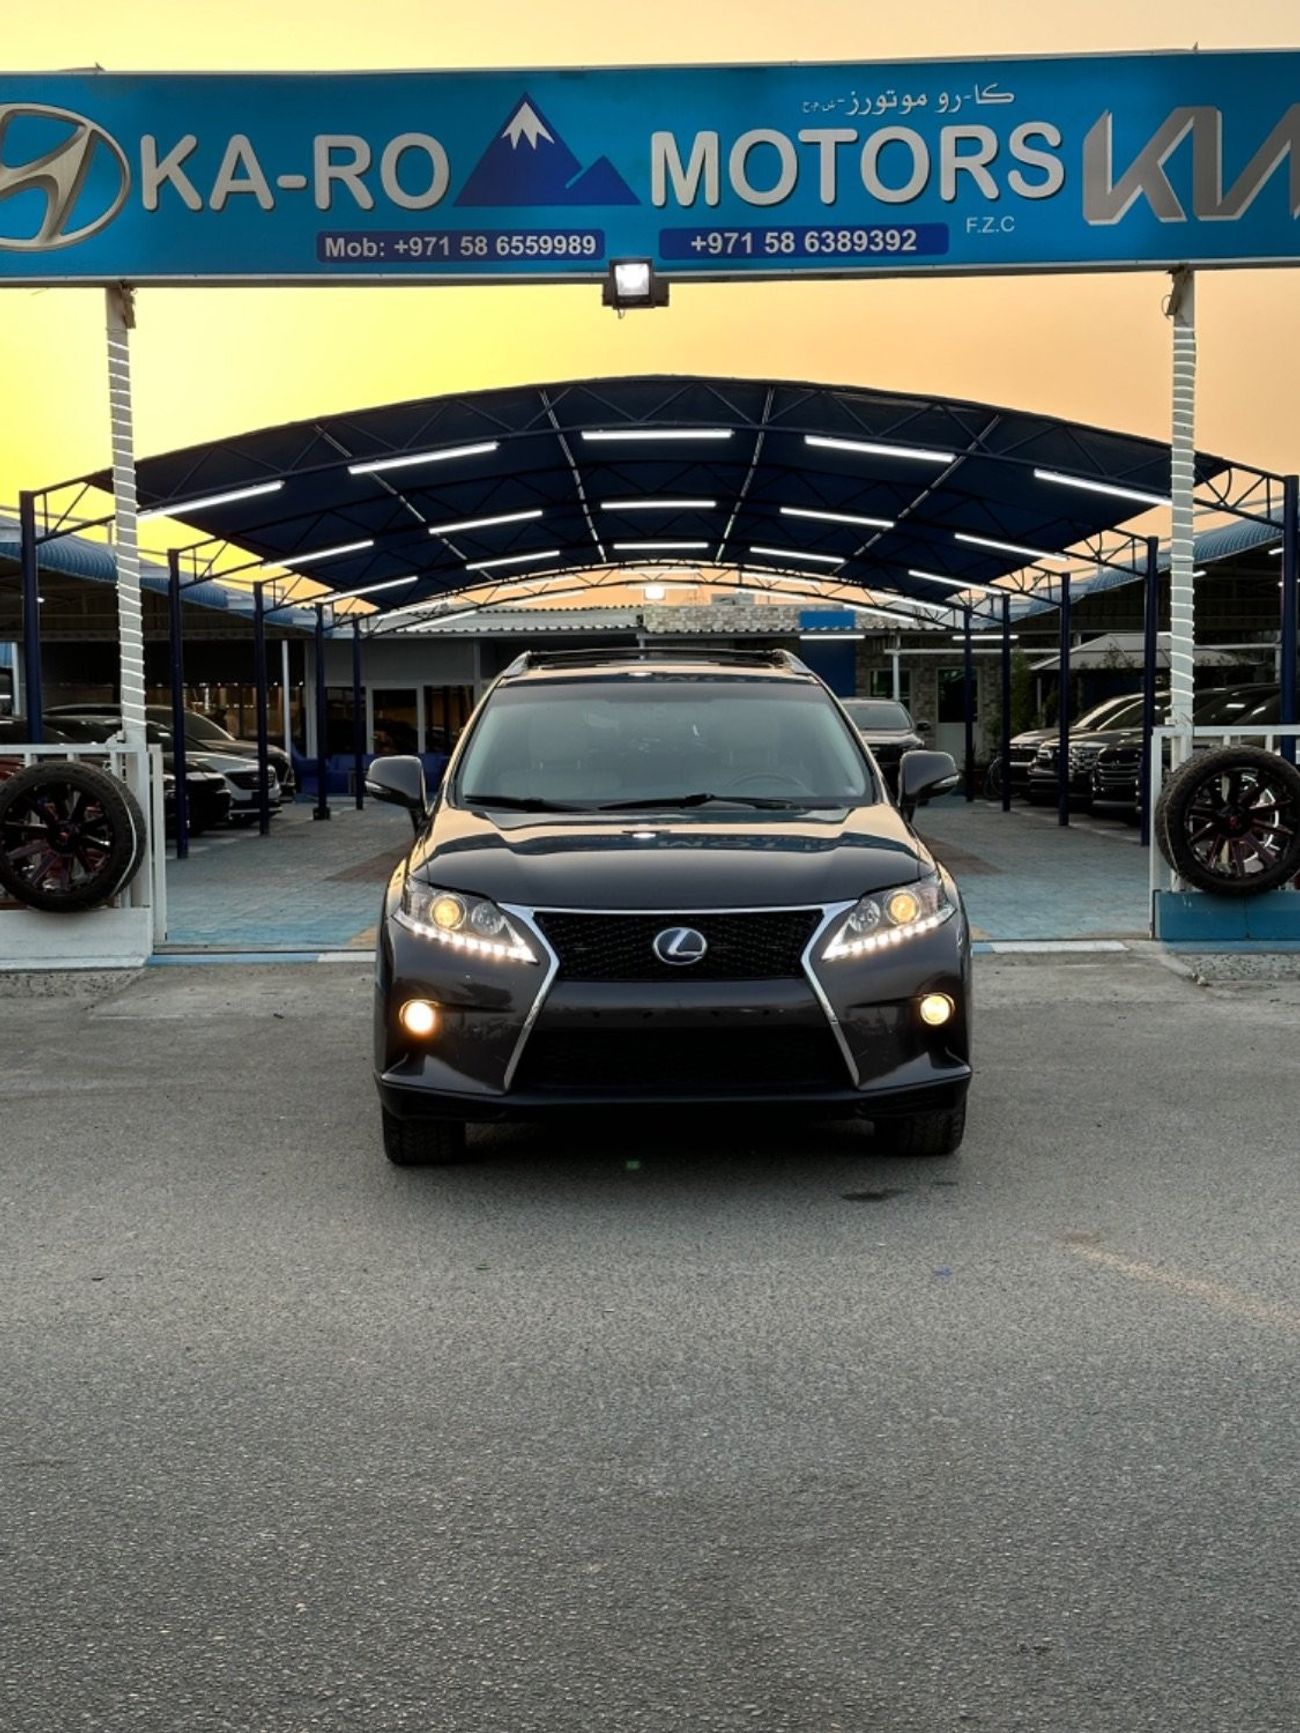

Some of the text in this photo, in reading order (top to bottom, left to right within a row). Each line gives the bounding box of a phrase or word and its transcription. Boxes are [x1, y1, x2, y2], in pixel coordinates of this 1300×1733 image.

[935, 83, 1015, 114] كا-رو
[140, 121, 1066, 211] KA-RO MOTORS
[965, 215, 1016, 234] F.Z.C
[325, 234, 597, 258] Mob: +971 58 6559989
[690, 229, 918, 255] +971 58 6389392
